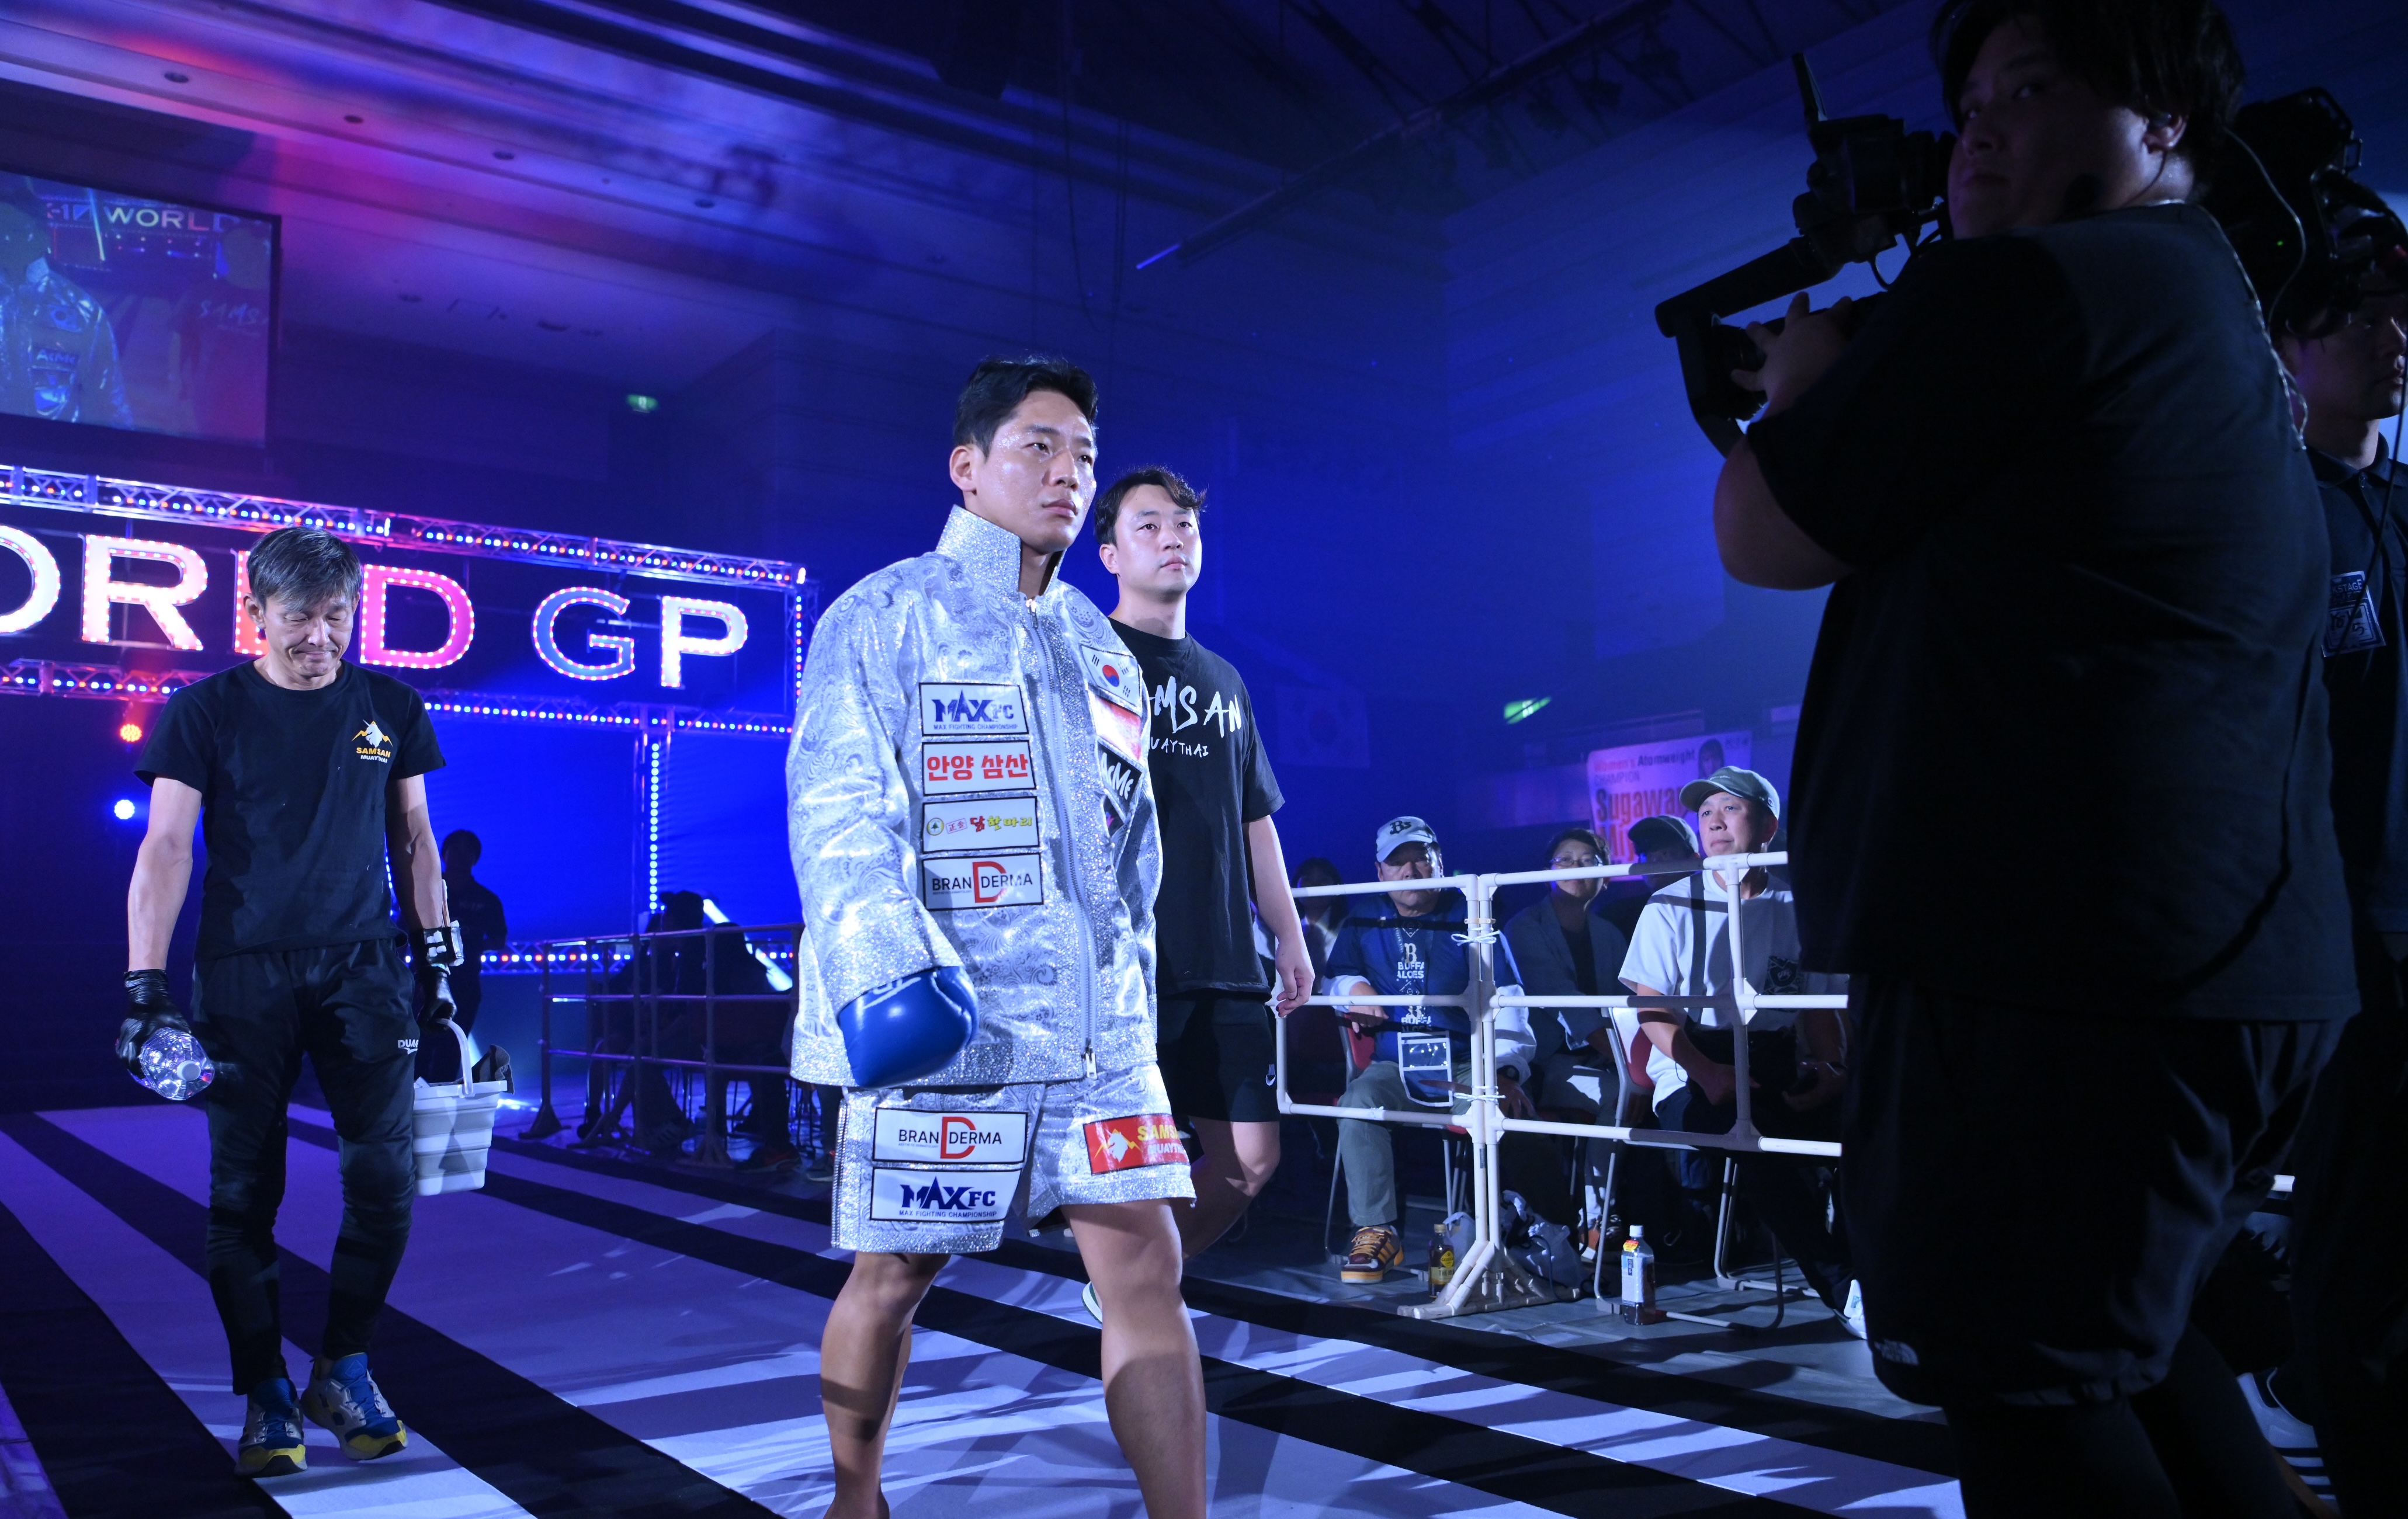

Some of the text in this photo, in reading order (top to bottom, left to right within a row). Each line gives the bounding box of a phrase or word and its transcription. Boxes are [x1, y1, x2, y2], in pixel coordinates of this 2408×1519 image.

[2331, 579, 2364, 594] KSTAGE
[532, 586, 748, 687] GP
[1149, 676, 1242, 738] MSAN
[356, 748, 391, 758] SAMSAN
[1149, 736, 1209, 758] UAYTHAI
[927, 753, 1028, 781] 안양 삼산
